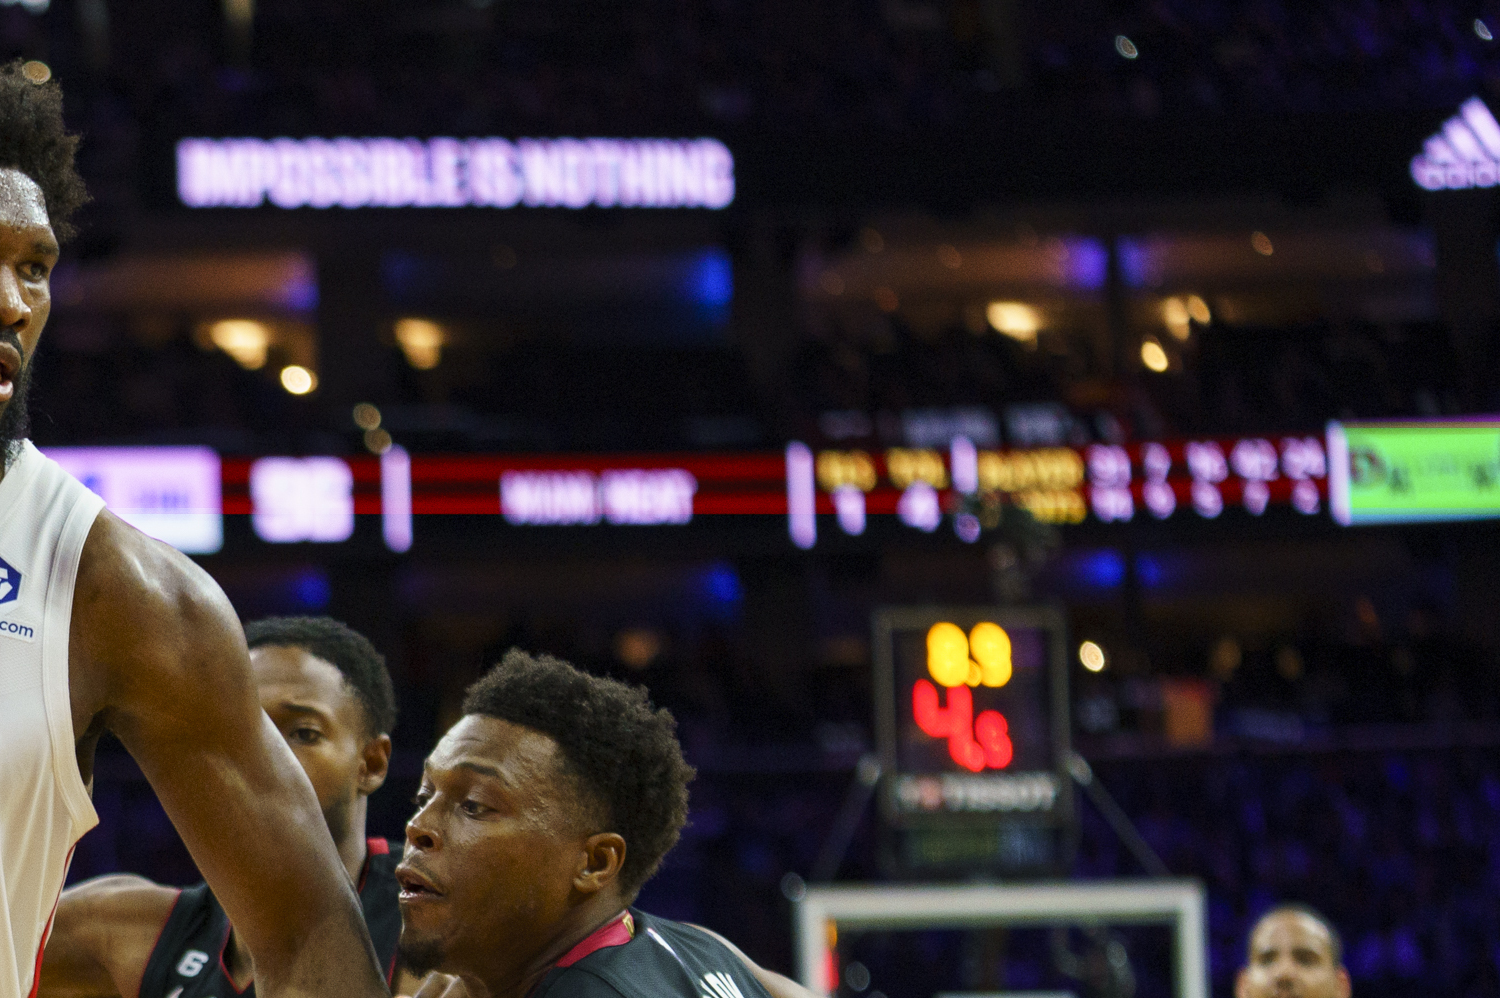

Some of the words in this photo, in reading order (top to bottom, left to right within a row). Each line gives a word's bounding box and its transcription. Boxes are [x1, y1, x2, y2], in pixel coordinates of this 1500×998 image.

[177, 136, 465, 208] IMPOSSIBLE
[467, 137, 522, 208] IS
[524, 137, 735, 209] NOTHING
[176, 950, 209, 977] 6
